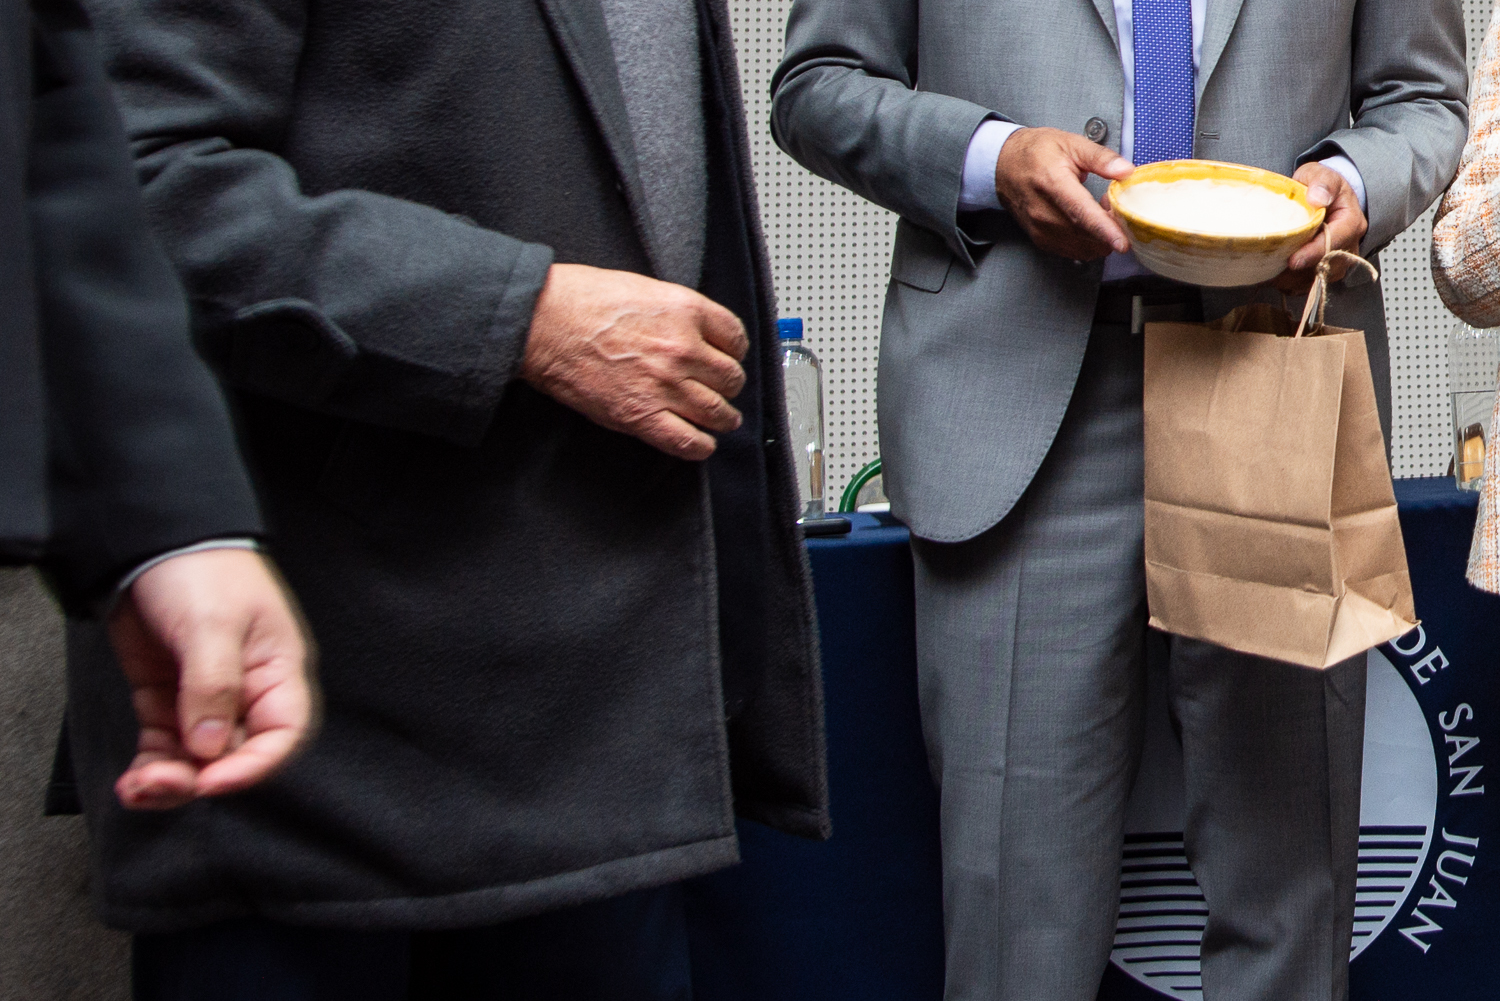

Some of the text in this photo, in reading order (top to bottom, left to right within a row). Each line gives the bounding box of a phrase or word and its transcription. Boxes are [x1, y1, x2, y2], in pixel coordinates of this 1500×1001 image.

[1389, 624, 1485, 954] DE SAN JUAN
